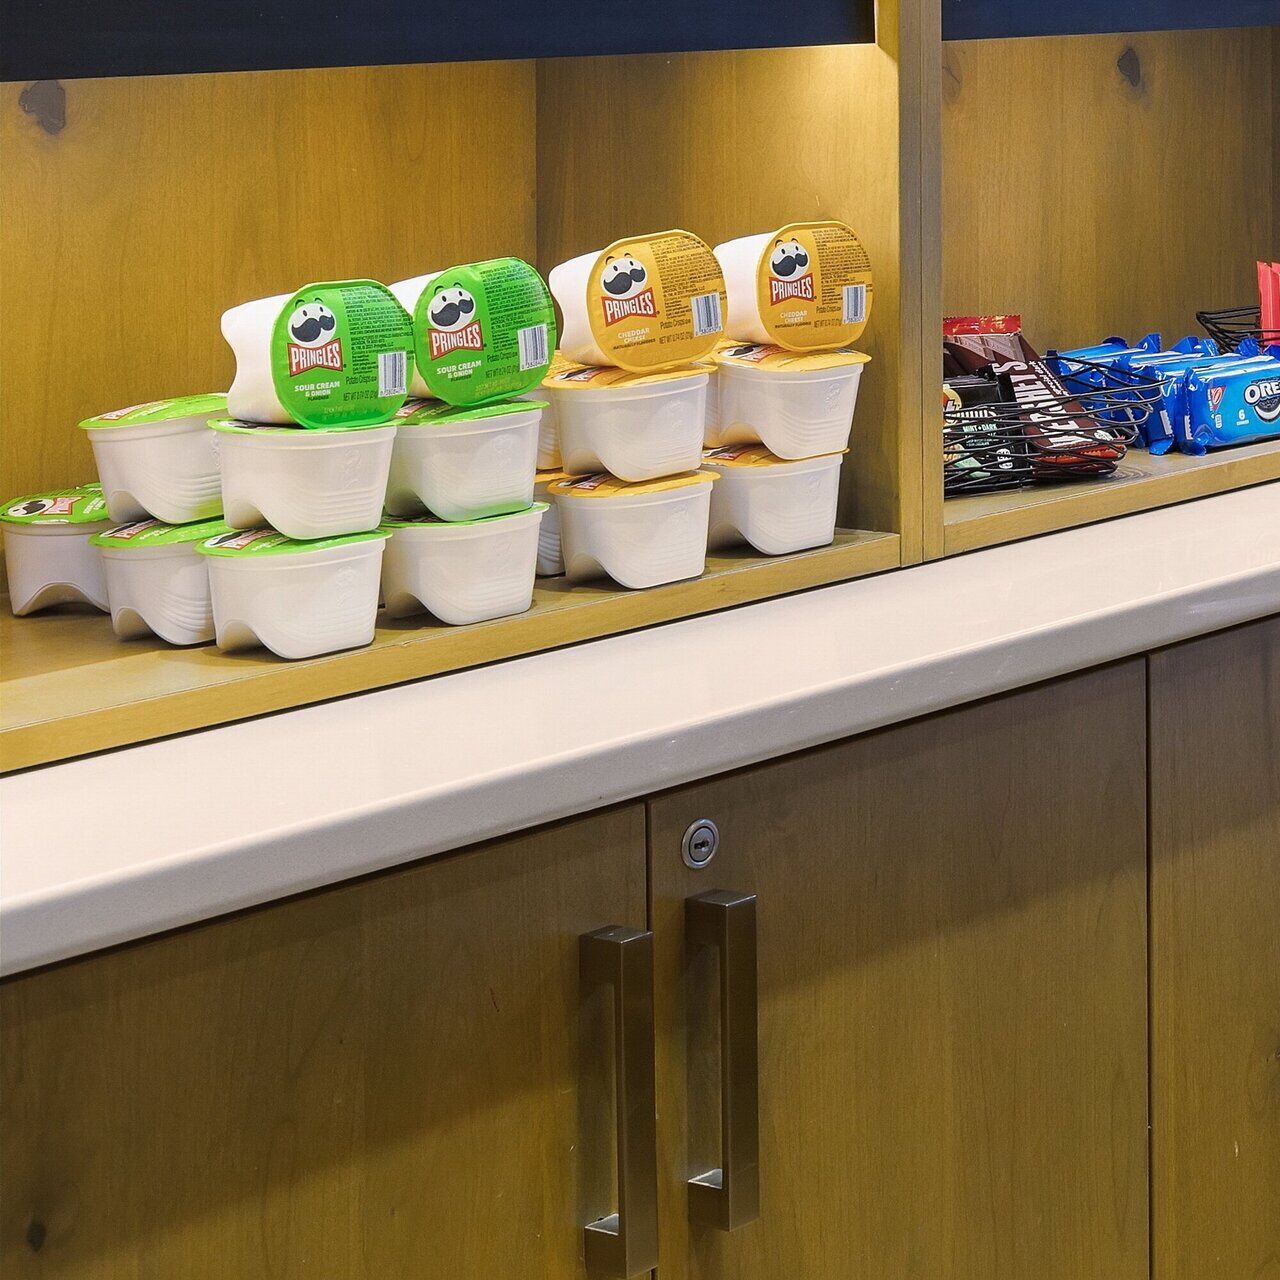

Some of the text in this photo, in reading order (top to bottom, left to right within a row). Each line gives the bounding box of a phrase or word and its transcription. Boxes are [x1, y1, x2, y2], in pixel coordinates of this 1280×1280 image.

[771, 276, 812, 302] PRINGLES
[604, 291, 654, 322] PRINGLES
[779, 311, 808, 319] CHEDDAR
[430, 322, 481, 356] PRINGLES
[617, 328, 650, 339] CHEDDAR
[289, 341, 341, 372] PRINGLES
[437, 360, 482, 375] SOUR CREAM
[294, 381, 340, 392] SOUR CREAM
[1238, 409, 1246, 420] 6
